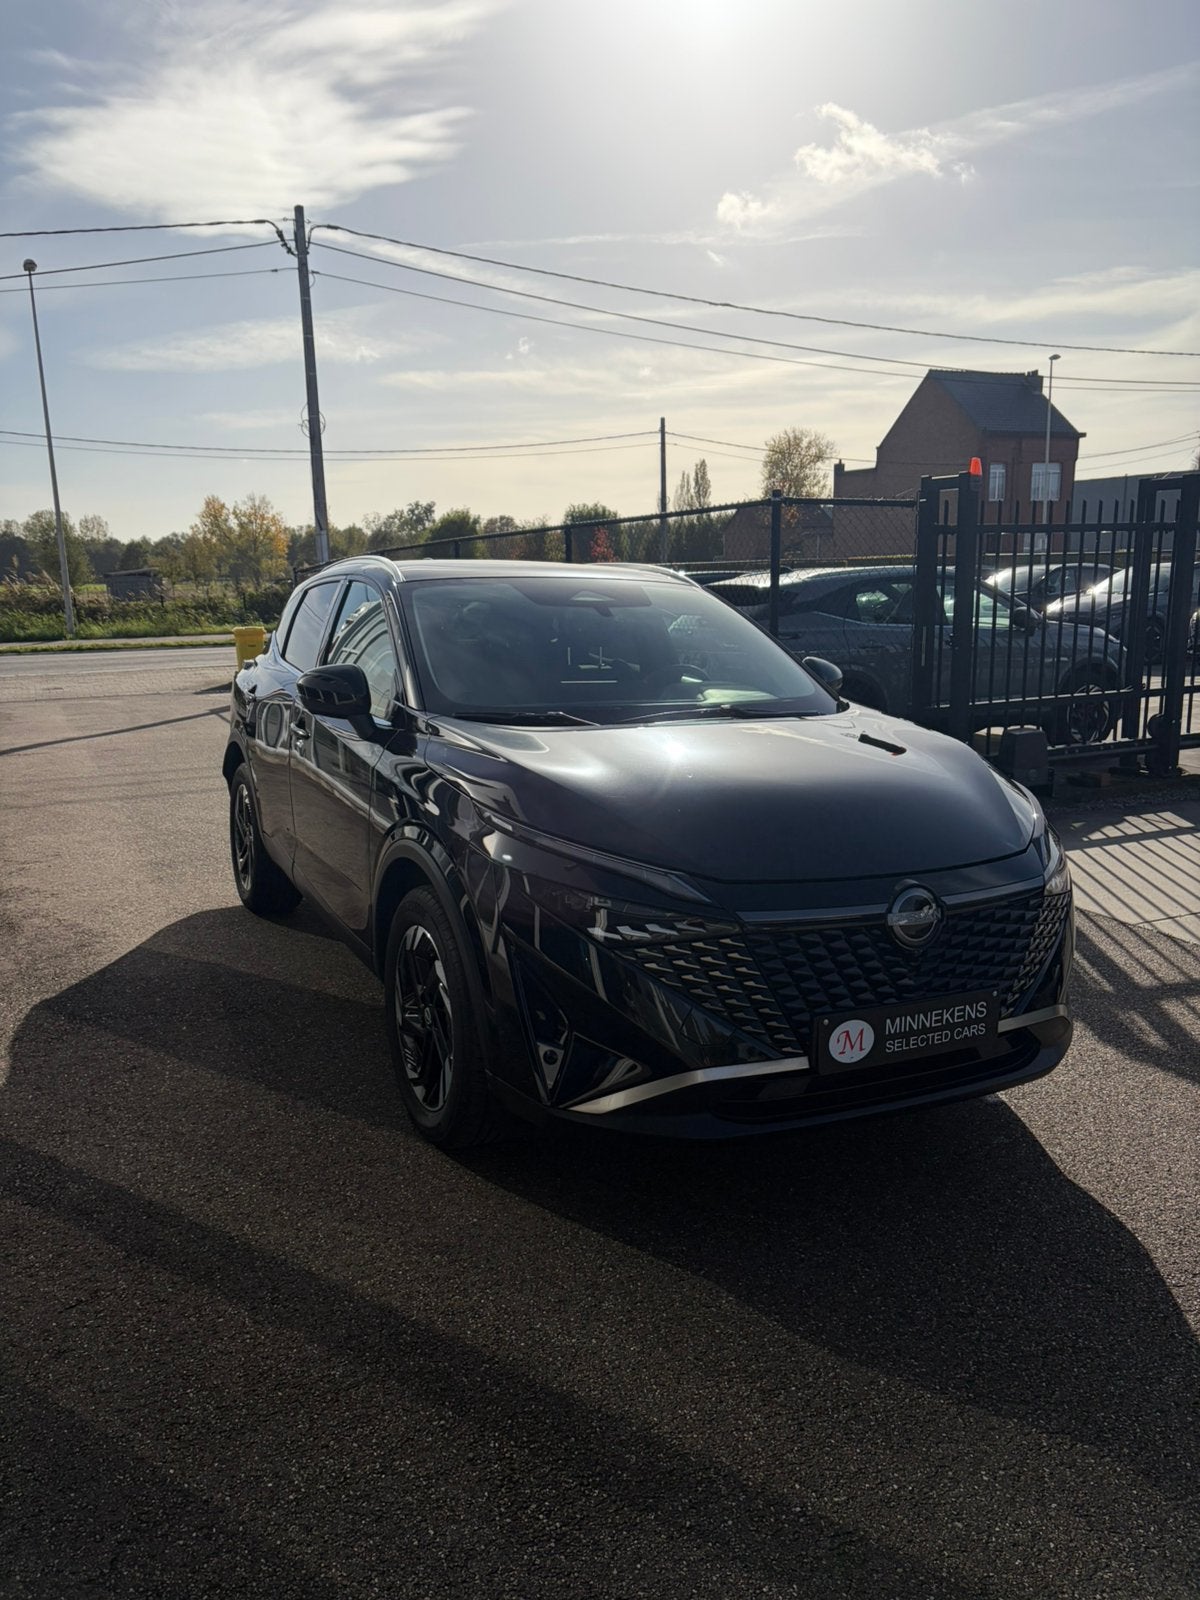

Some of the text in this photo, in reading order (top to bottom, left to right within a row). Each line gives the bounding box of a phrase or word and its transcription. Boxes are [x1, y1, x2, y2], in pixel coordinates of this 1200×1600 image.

[886, 1001, 987, 1035] MINNEKENS
[837, 1028, 866, 1055] M
[885, 1023, 986, 1053] SELECTED CARS
